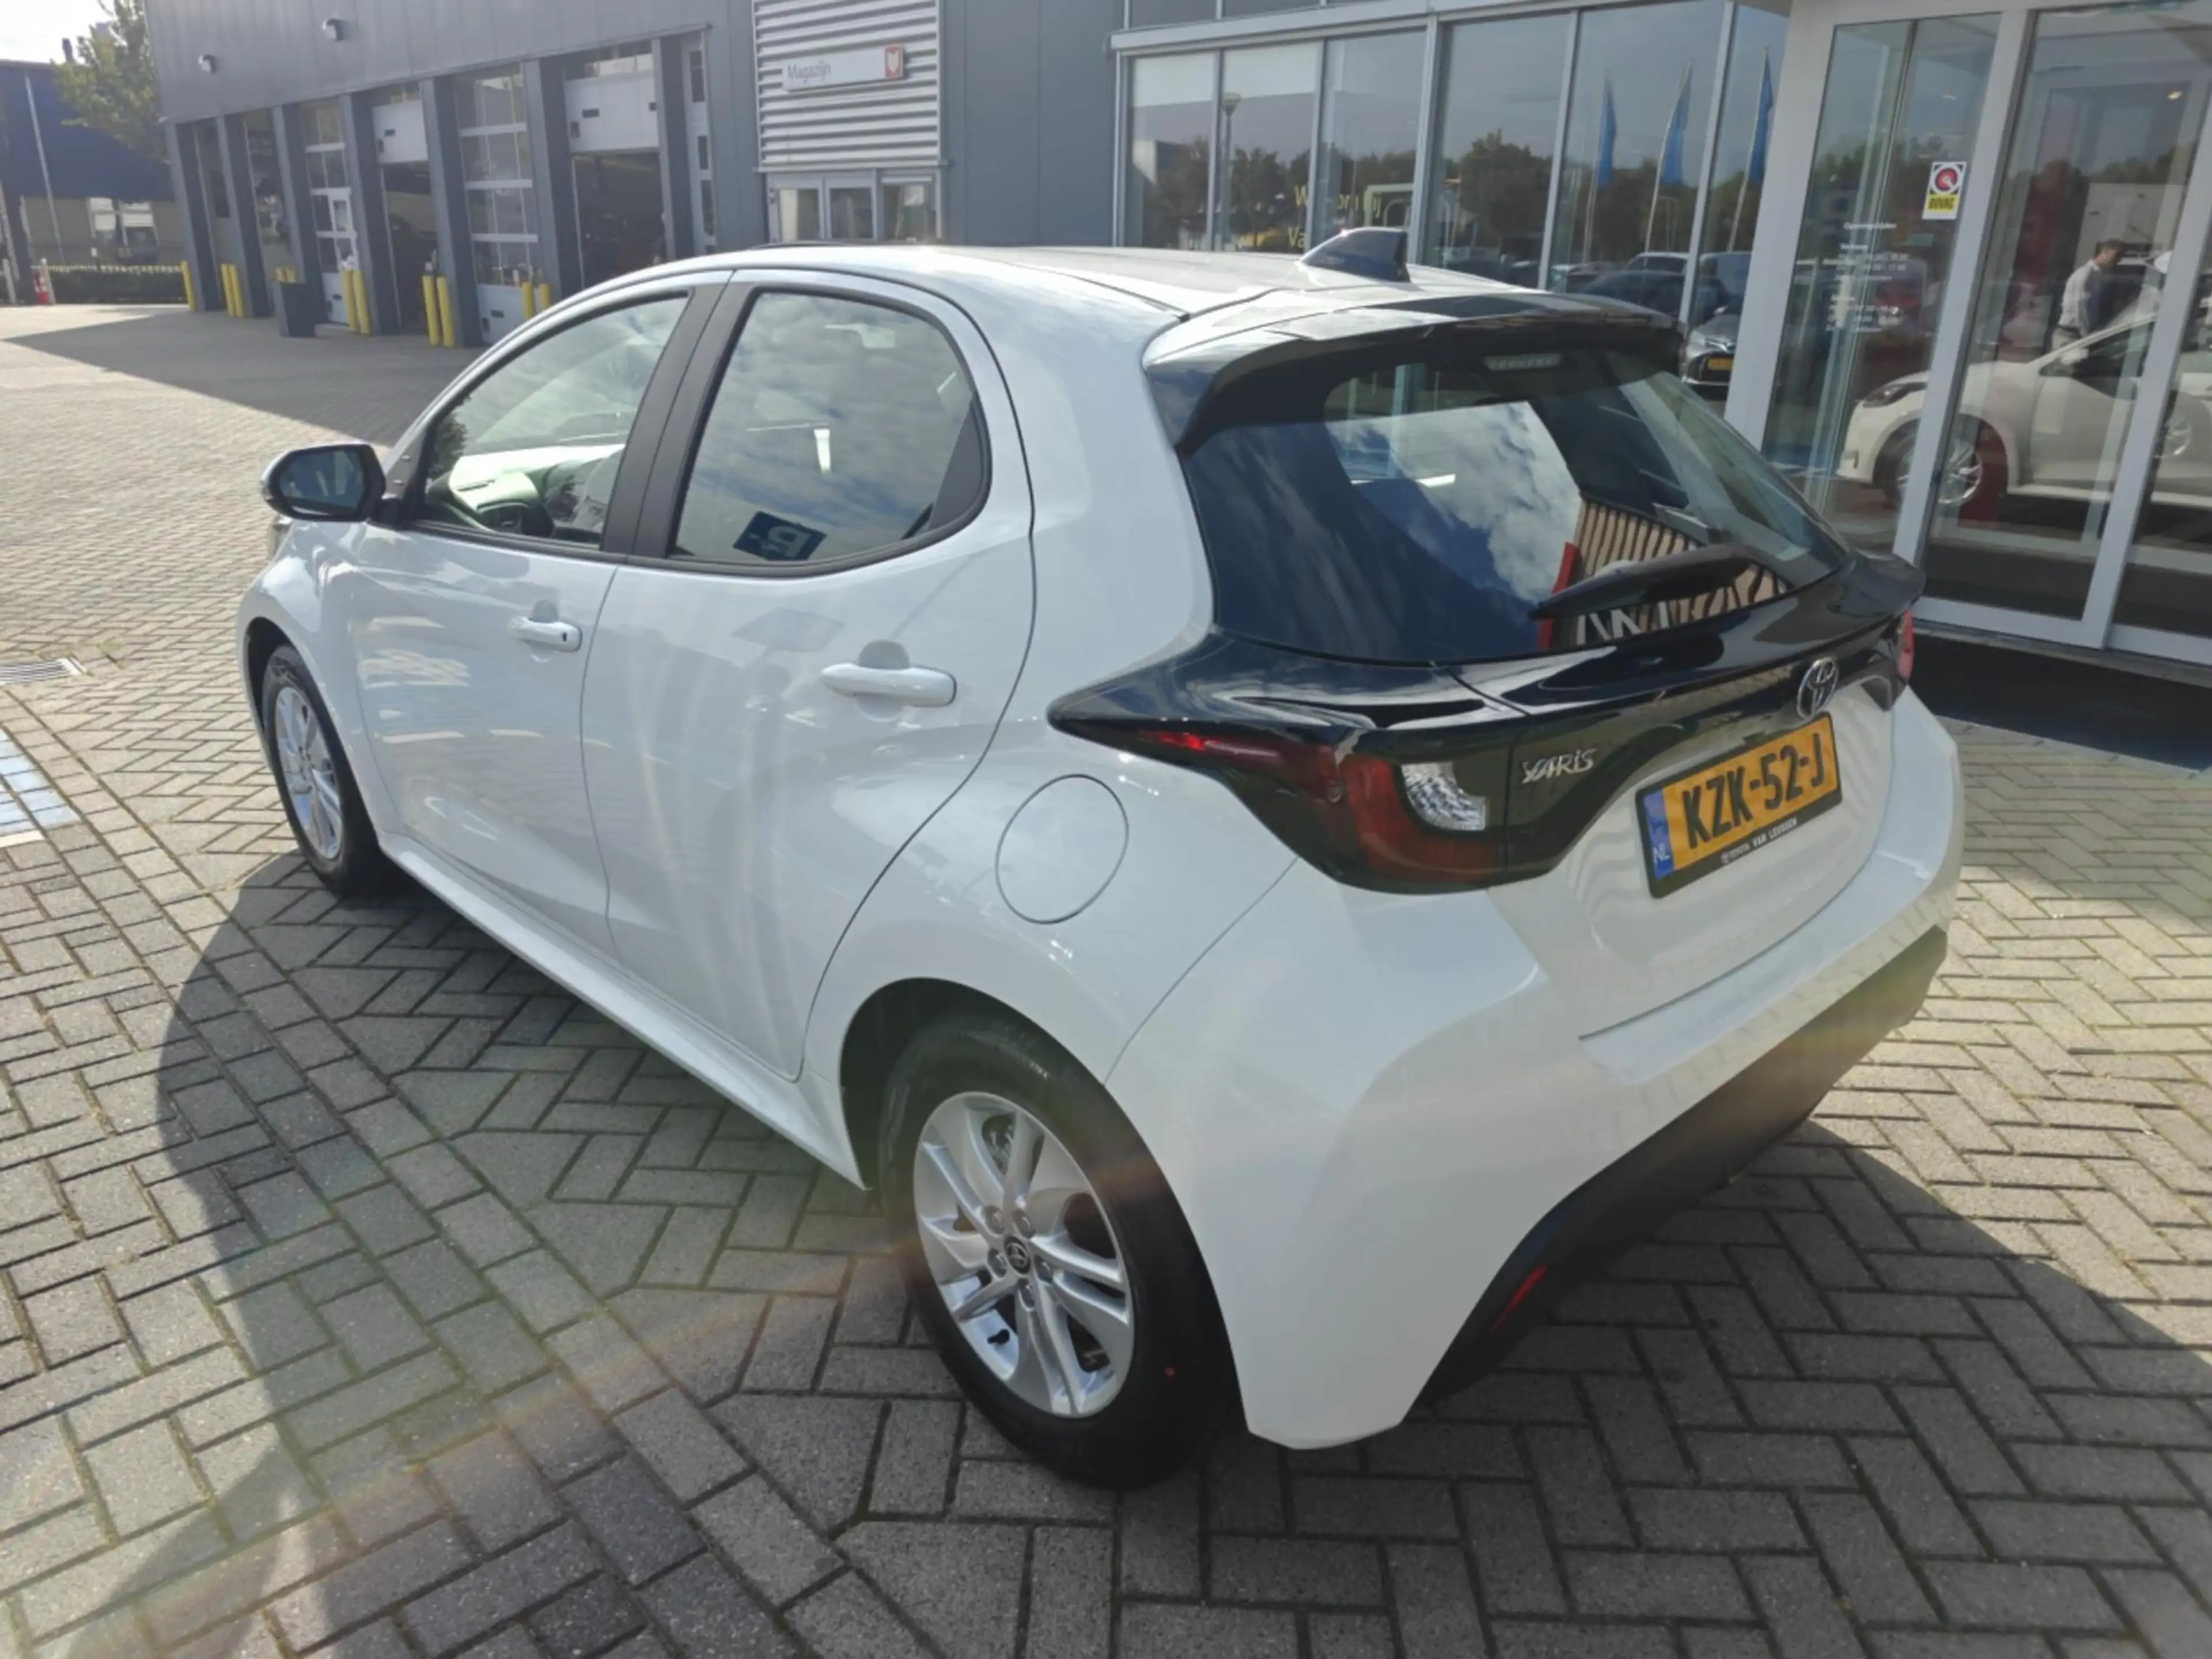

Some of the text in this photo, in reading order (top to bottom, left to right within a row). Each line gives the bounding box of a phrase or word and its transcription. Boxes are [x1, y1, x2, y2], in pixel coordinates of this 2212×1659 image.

[787, 61, 831, 84] Magazijn
[1522, 748, 1597, 784] YARIS
[1682, 732, 1825, 850] KZK-52-J
[1653, 843, 1670, 864] NL
